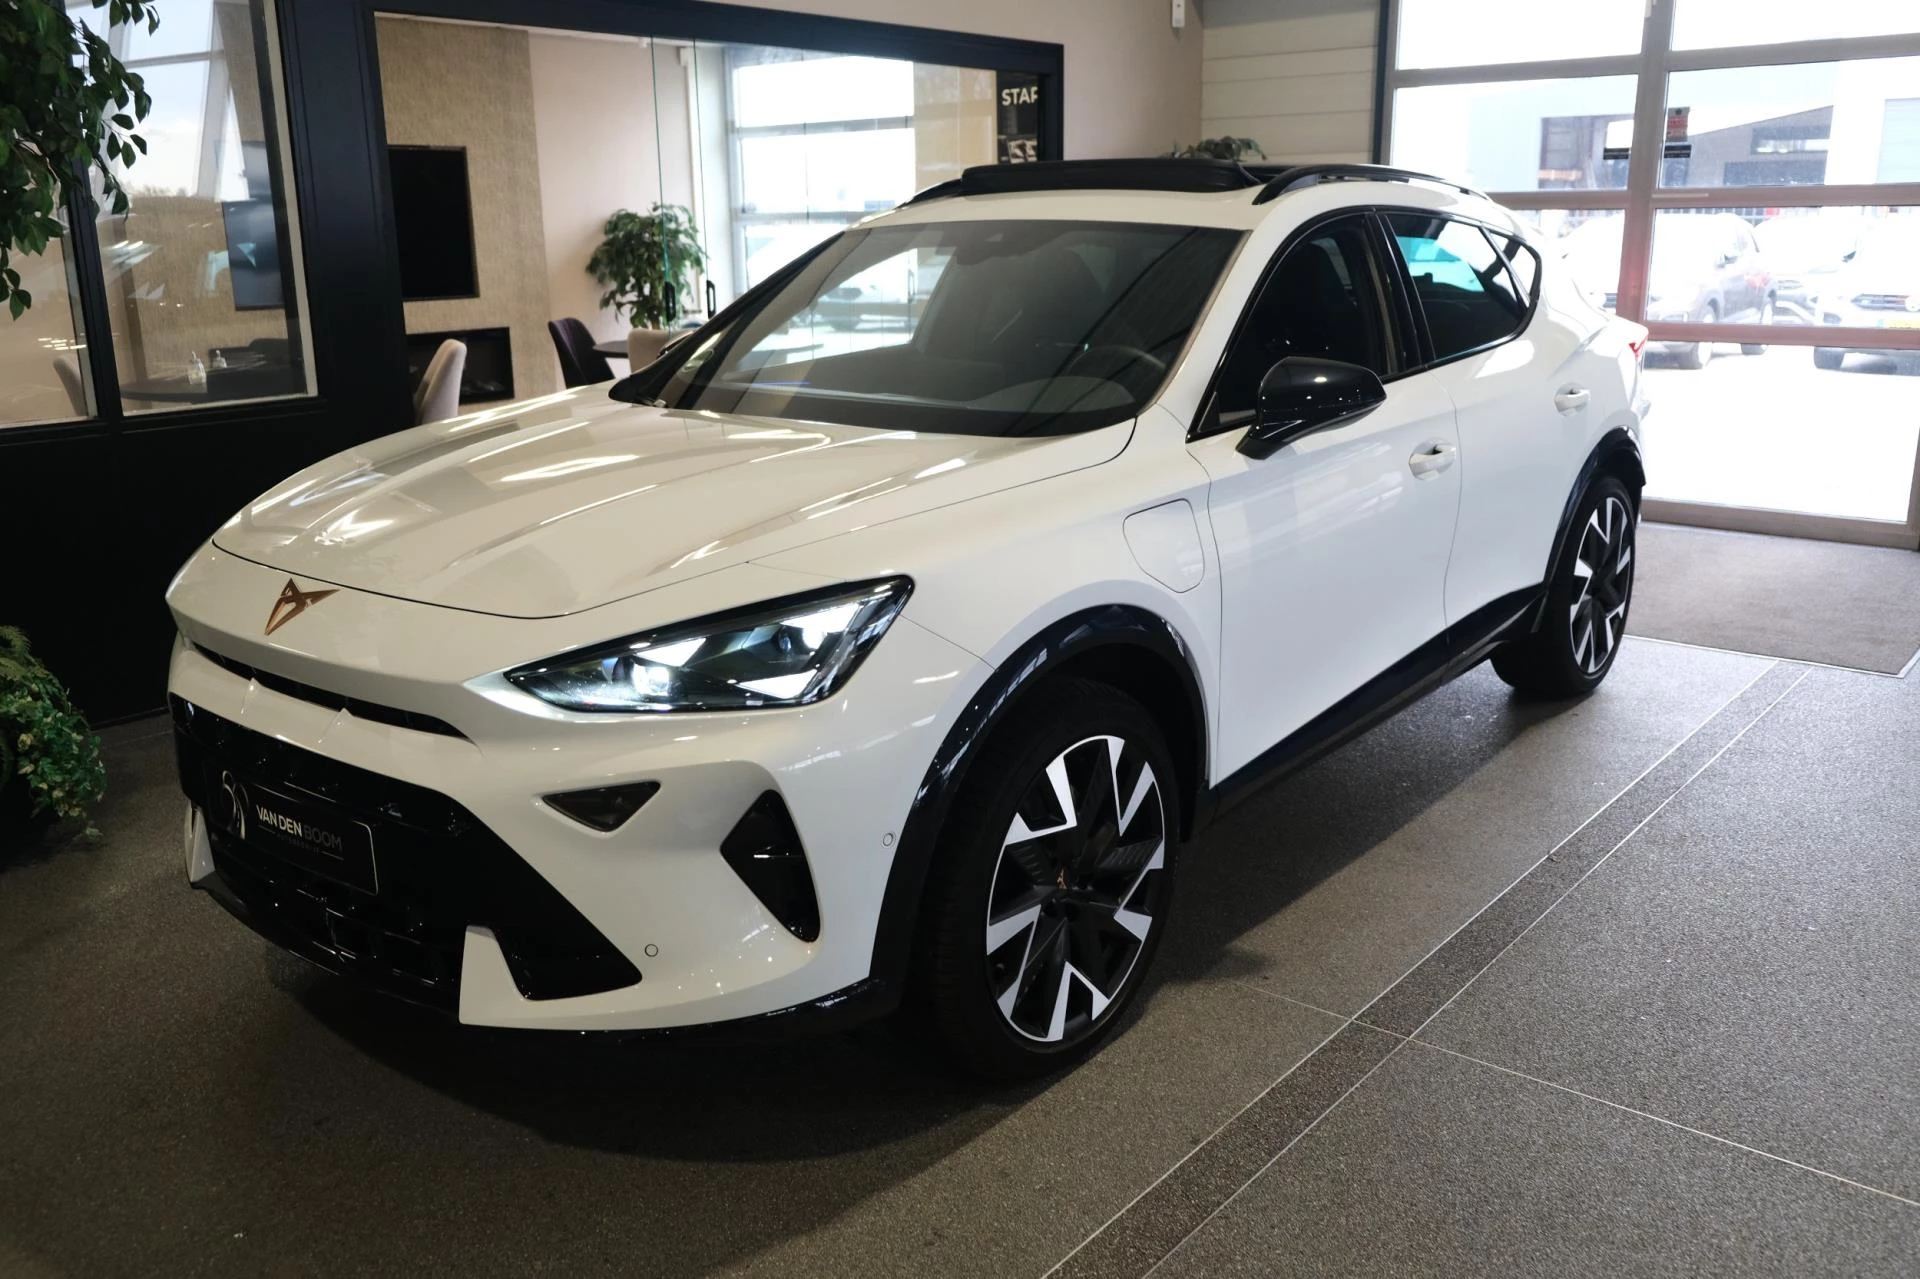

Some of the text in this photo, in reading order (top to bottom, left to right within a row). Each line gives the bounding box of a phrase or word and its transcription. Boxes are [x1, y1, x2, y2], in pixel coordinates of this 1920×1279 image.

[256, 804, 278, 827] VAN
[278, 814, 303, 837] DEN
[303, 825, 342, 851] BOOM
